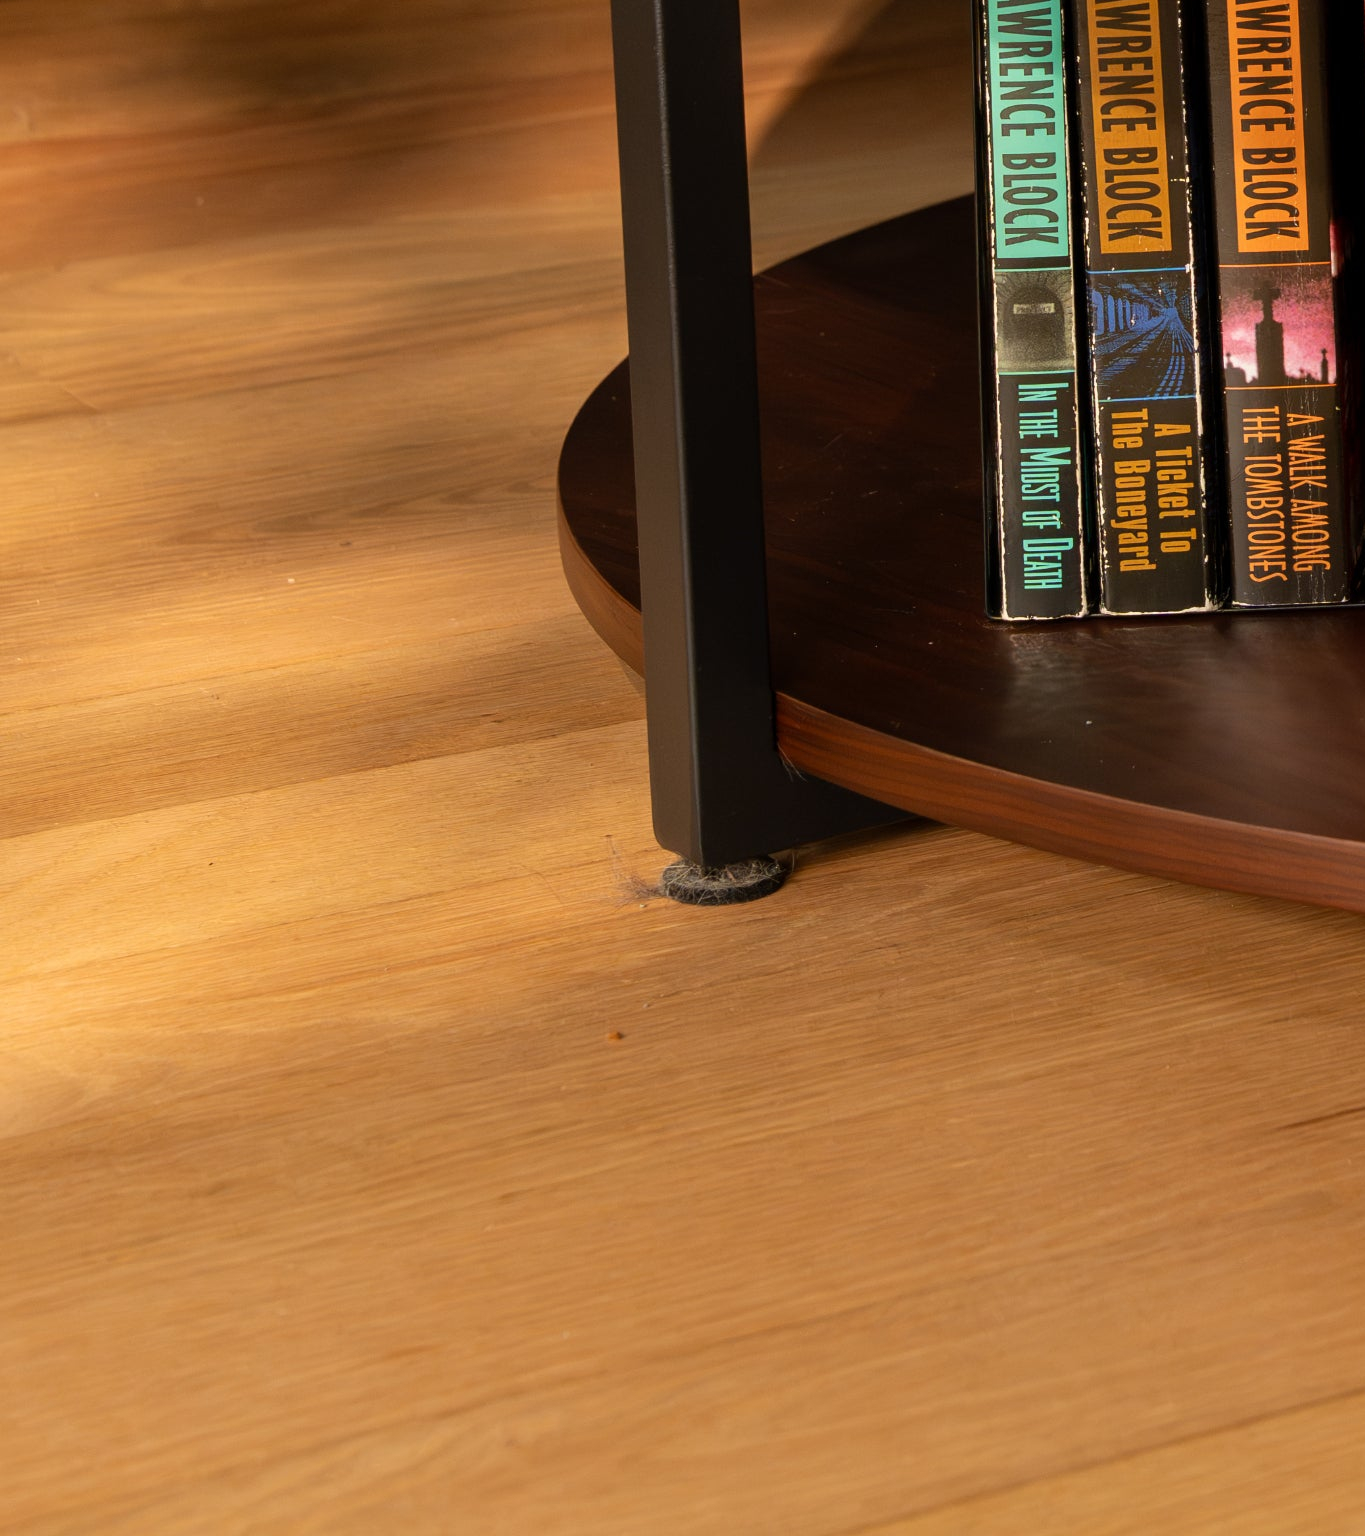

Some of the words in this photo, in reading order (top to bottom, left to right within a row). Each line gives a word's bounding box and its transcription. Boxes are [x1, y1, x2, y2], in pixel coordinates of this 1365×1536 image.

[1002, 152, 1060, 246] BLOCK
[1104, 148, 1163, 242] BLOCK
[1242, 147, 1301, 241] BLOCK
[1111, 408, 1149, 449] The
[1154, 423, 1191, 438] A
[1242, 405, 1281, 444] THE
[1286, 413, 1325, 427] A
[1155, 446, 1196, 519] Ticket
[1287, 434, 1328, 490] WALK
[1110, 459, 1157, 572] Boneyard
[1160, 527, 1197, 553] To
[1244, 453, 1288, 583] TOMBSTONES
[1290, 498, 1331, 572] AMONG
